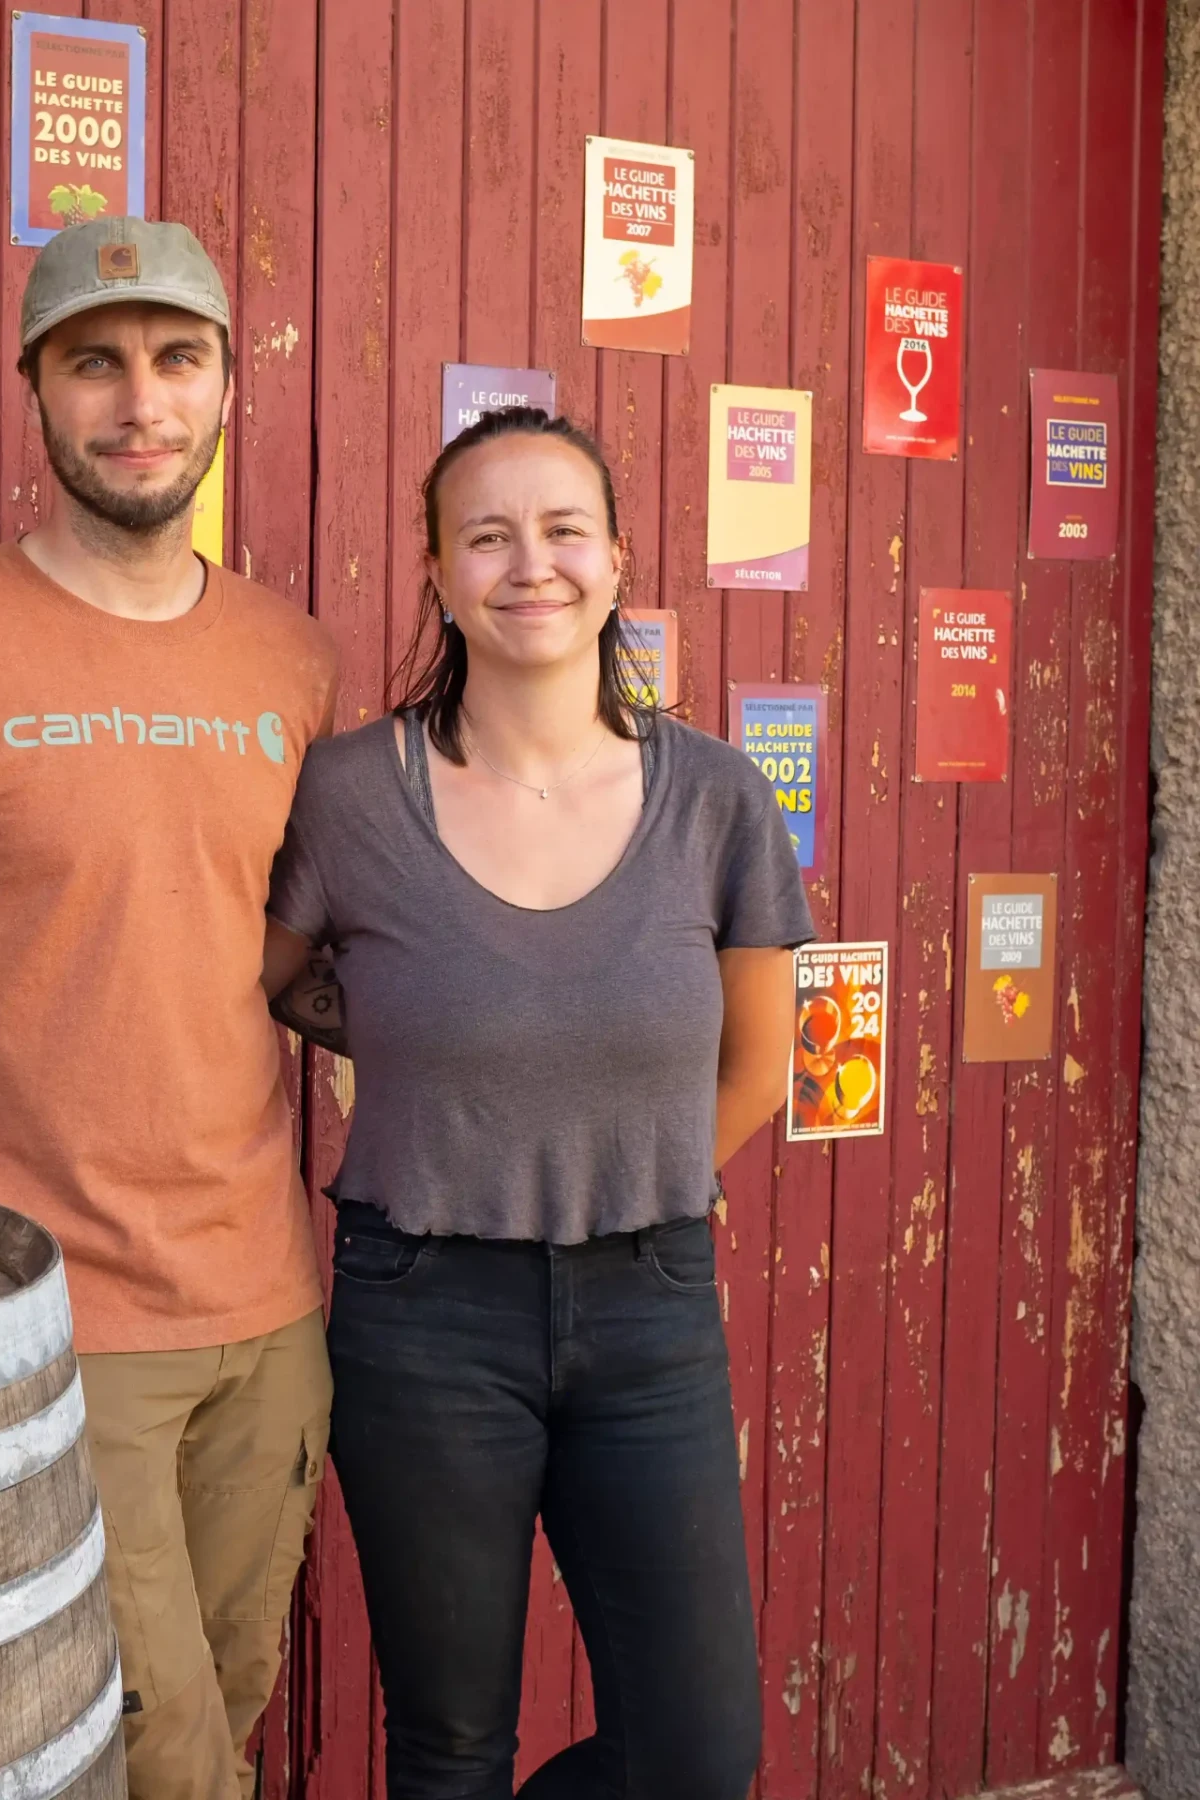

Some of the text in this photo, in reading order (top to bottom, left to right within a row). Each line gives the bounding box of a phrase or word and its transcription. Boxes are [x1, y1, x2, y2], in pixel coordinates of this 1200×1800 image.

[35, 70, 122, 94] LE GUIDE
[35, 92, 122, 113] HACHETTE
[35, 112, 122, 148] 2000
[35, 147, 122, 171] DES VINS
[614, 168, 665, 186] LE GUIDE
[604, 182, 676, 204] HACHETTE
[612, 202, 666, 220] DES VINS
[626, 224, 651, 236] 2007
[886, 288, 947, 308] LE GUIDE
[885, 304, 948, 322] HACHETTE
[885, 317, 948, 338] DES VINS
[904, 340, 926, 350] 2016
[472, 392, 528, 406] LE GUIDE
[738, 412, 785, 426] LE GUIDE
[728, 426, 795, 444] HACHETTE
[1051, 426, 1102, 442] LE GUIDE
[735, 445, 787, 461] DES VINS
[1047, 443, 1106, 460] HACHETTE
[1069, 462, 1103, 480] VINS
[1058, 523, 1088, 538] 2003
[735, 567, 782, 580] SÉLECTION
[944, 612, 986, 625] LE GUIDE
[934, 627, 995, 643] HACHETTE
[941, 646, 987, 660] DES VINS
[952, 684, 976, 697] 2014
[3, 707, 250, 755] carhartt
[746, 723, 812, 737] LE GUIDE
[746, 742, 812, 753] HACHETTE
[776, 789, 811, 812] NS
[992, 902, 1033, 915] LE GUIDE
[982, 916, 1041, 931] HACHETTE
[989, 932, 1034, 946] DES VINS
[799, 951, 881, 964] LE GUIDE HACHETTE
[798, 964, 881, 988] DES VINS
[852, 991, 880, 1013] 20
[850, 1014, 880, 1039] 24
